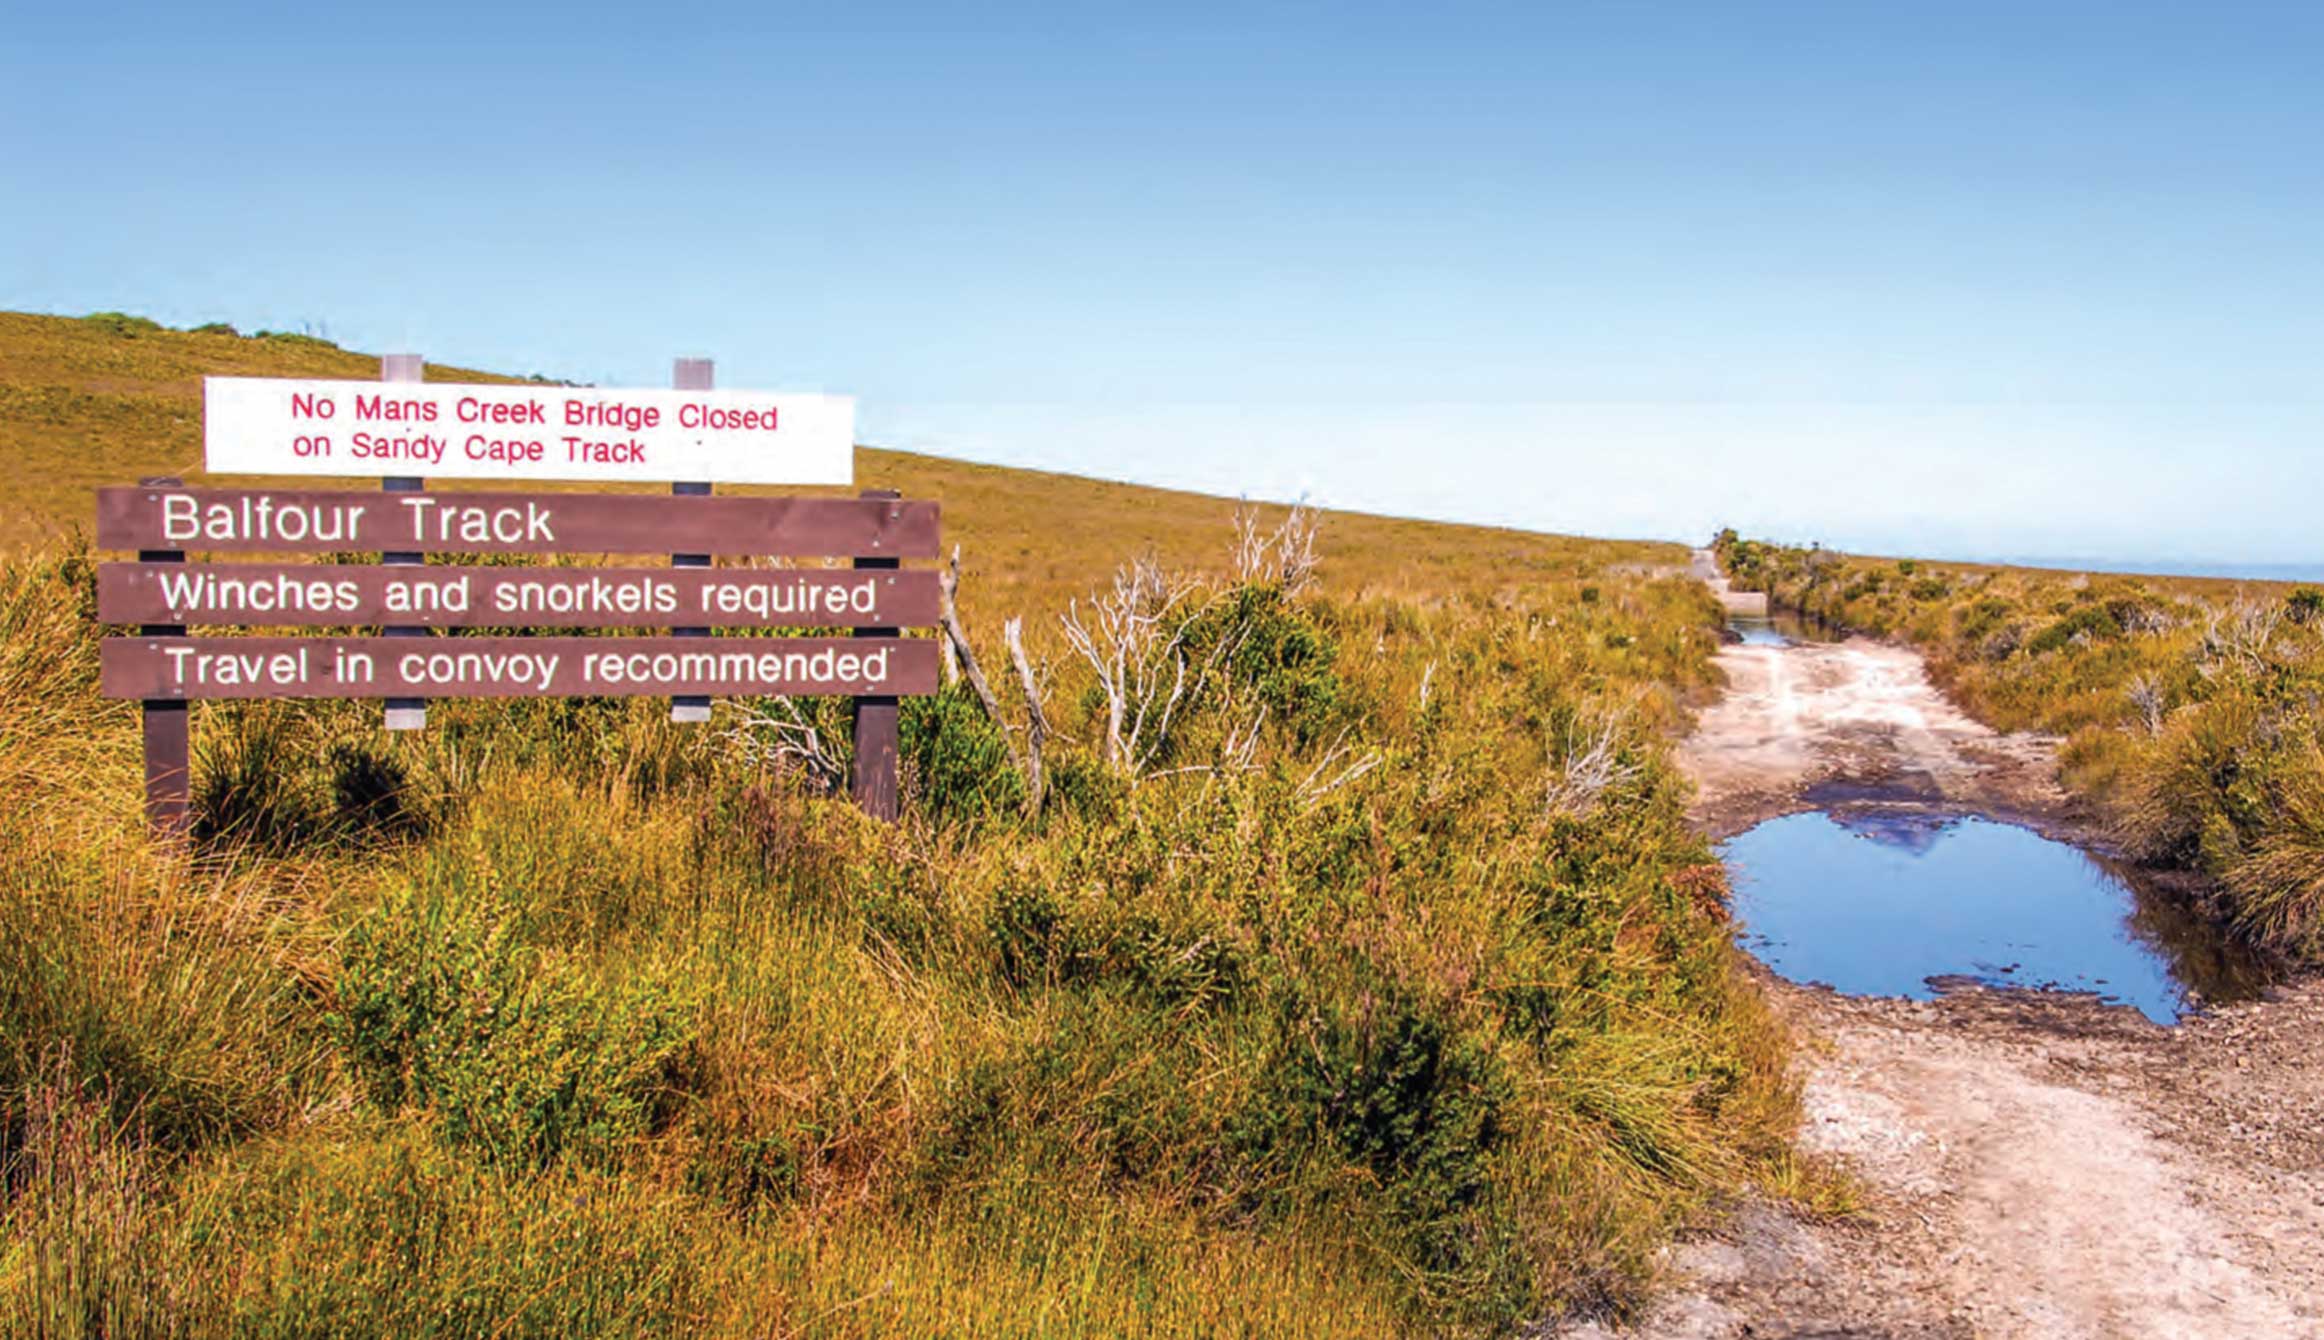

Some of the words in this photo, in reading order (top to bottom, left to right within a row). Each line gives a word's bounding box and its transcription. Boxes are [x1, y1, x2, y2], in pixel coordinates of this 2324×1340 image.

[292, 394, 335, 419] No
[356, 396, 437, 421] Mans
[457, 398, 544, 424] Creek
[565, 400, 659, 431] Bridge
[679, 404, 777, 430] Closed
[294, 436, 330, 456] on
[353, 433, 444, 464] Sandy
[465, 435, 544, 464] Cape
[564, 437, 645, 462] Track
[164, 495, 364, 540] Balfour
[402, 498, 553, 542] Track
[160, 573, 358, 610] Winches
[386, 576, 468, 611] and
[496, 577, 676, 612] snorkels
[702, 580, 874, 618] required
[165, 648, 306, 684] Travel
[336, 647, 372, 682] in
[400, 654, 558, 690] convoy
[585, 648, 886, 682] recommended
